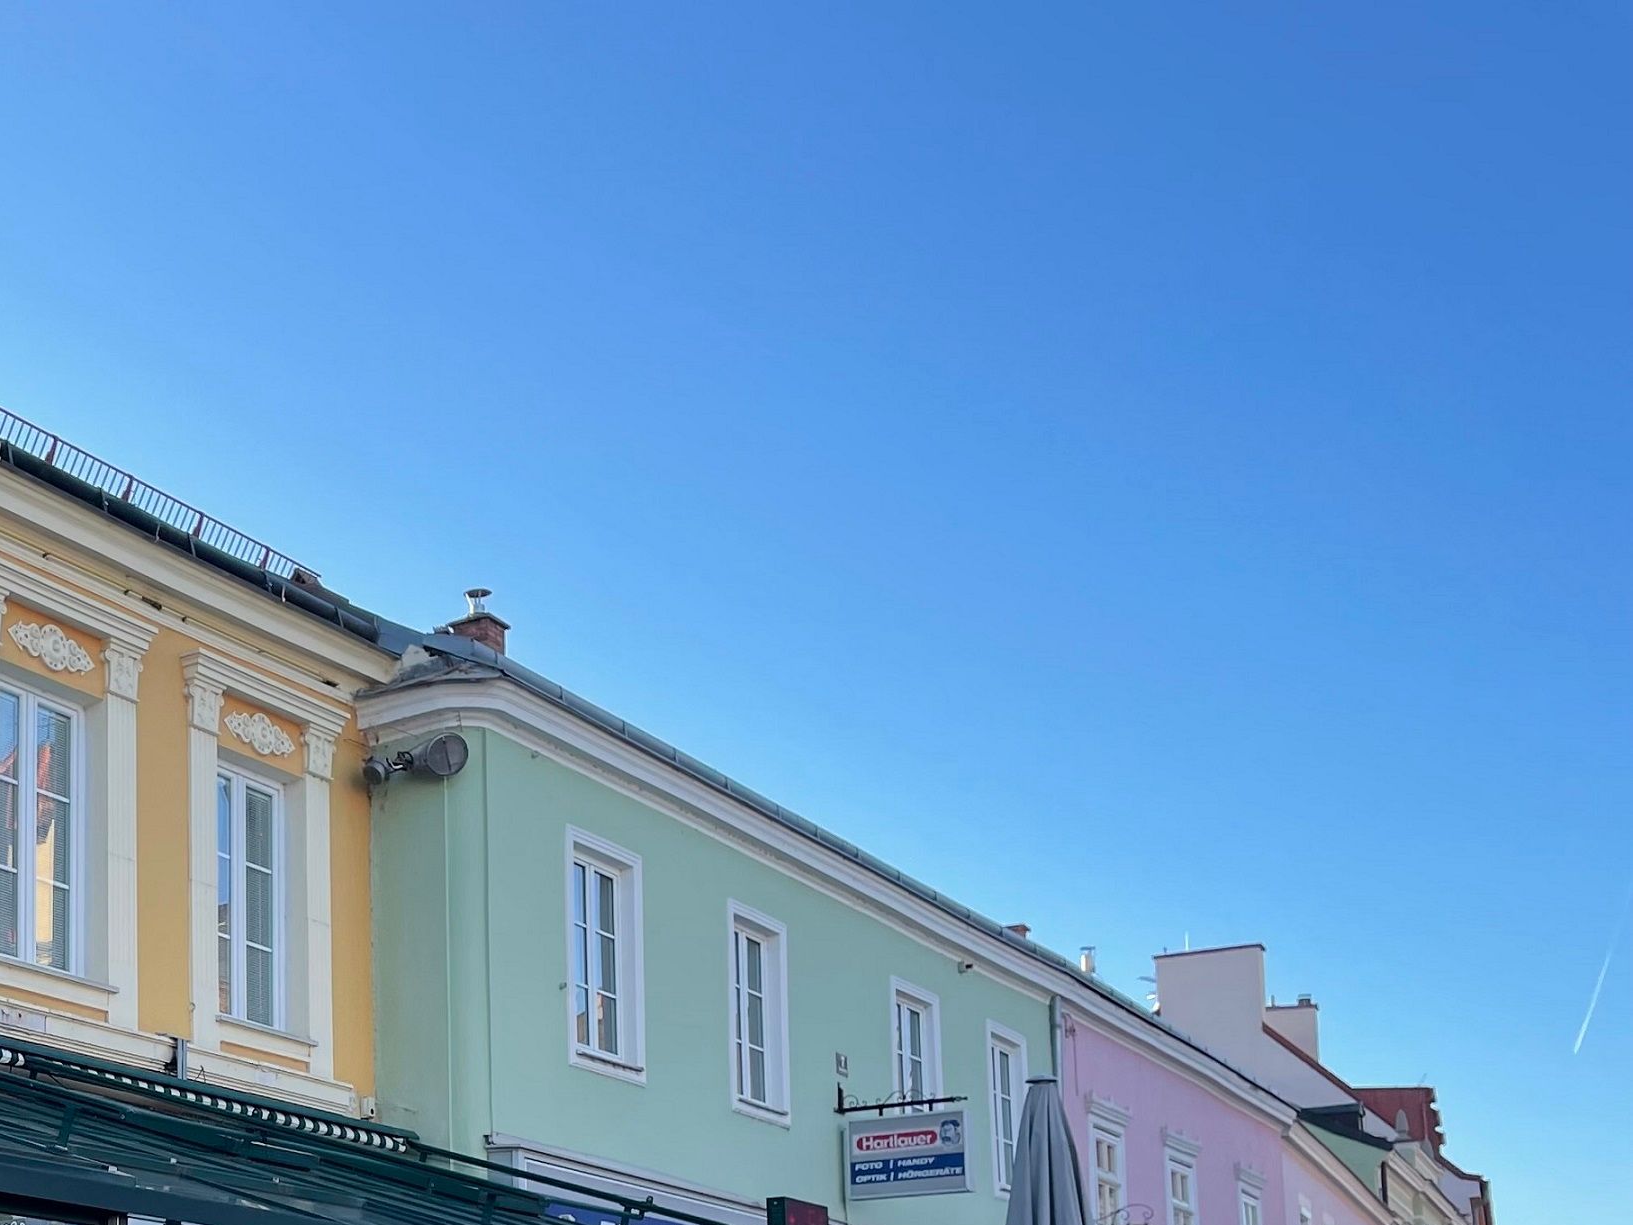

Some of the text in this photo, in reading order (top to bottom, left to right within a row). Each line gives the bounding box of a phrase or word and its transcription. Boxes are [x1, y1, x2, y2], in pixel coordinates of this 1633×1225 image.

[862, 1132, 933, 1150] Hartlauer
[855, 1156, 935, 1171] FOTO HANDY
[856, 1173, 887, 1184] OPTIK
